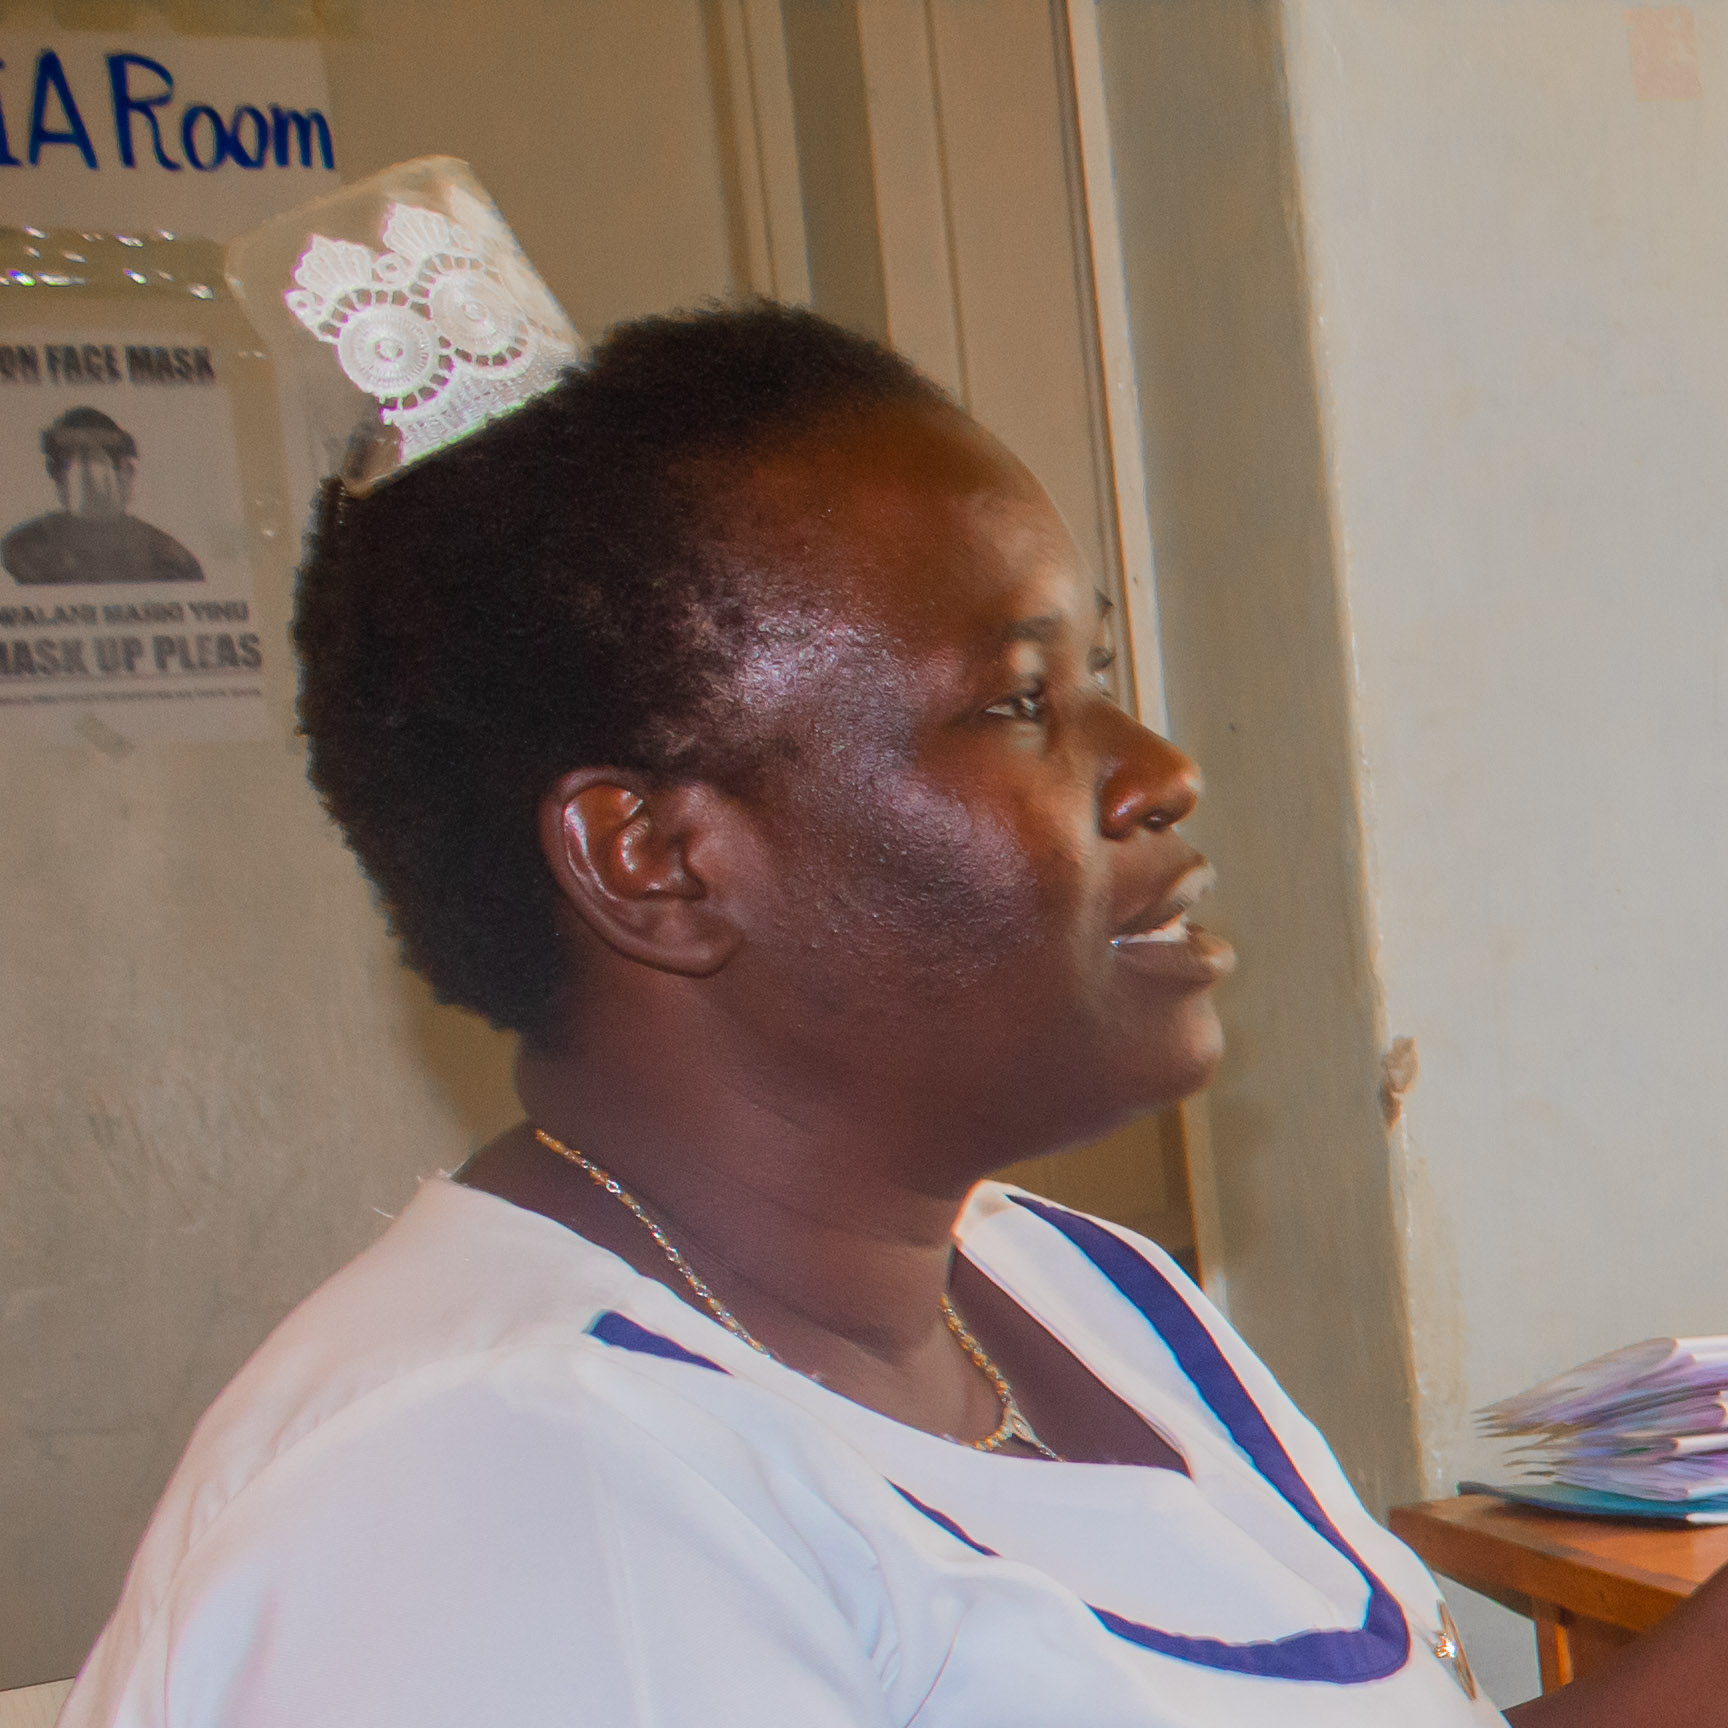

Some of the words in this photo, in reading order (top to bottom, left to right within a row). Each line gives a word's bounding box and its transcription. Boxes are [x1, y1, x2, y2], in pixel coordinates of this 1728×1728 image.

[104, 53, 335, 172] Room
[45, 344, 122, 385] FACE
[125, 345, 215, 384] MASK
[95, 636, 143, 674] UP
[152, 632, 262, 674] PLEAS
